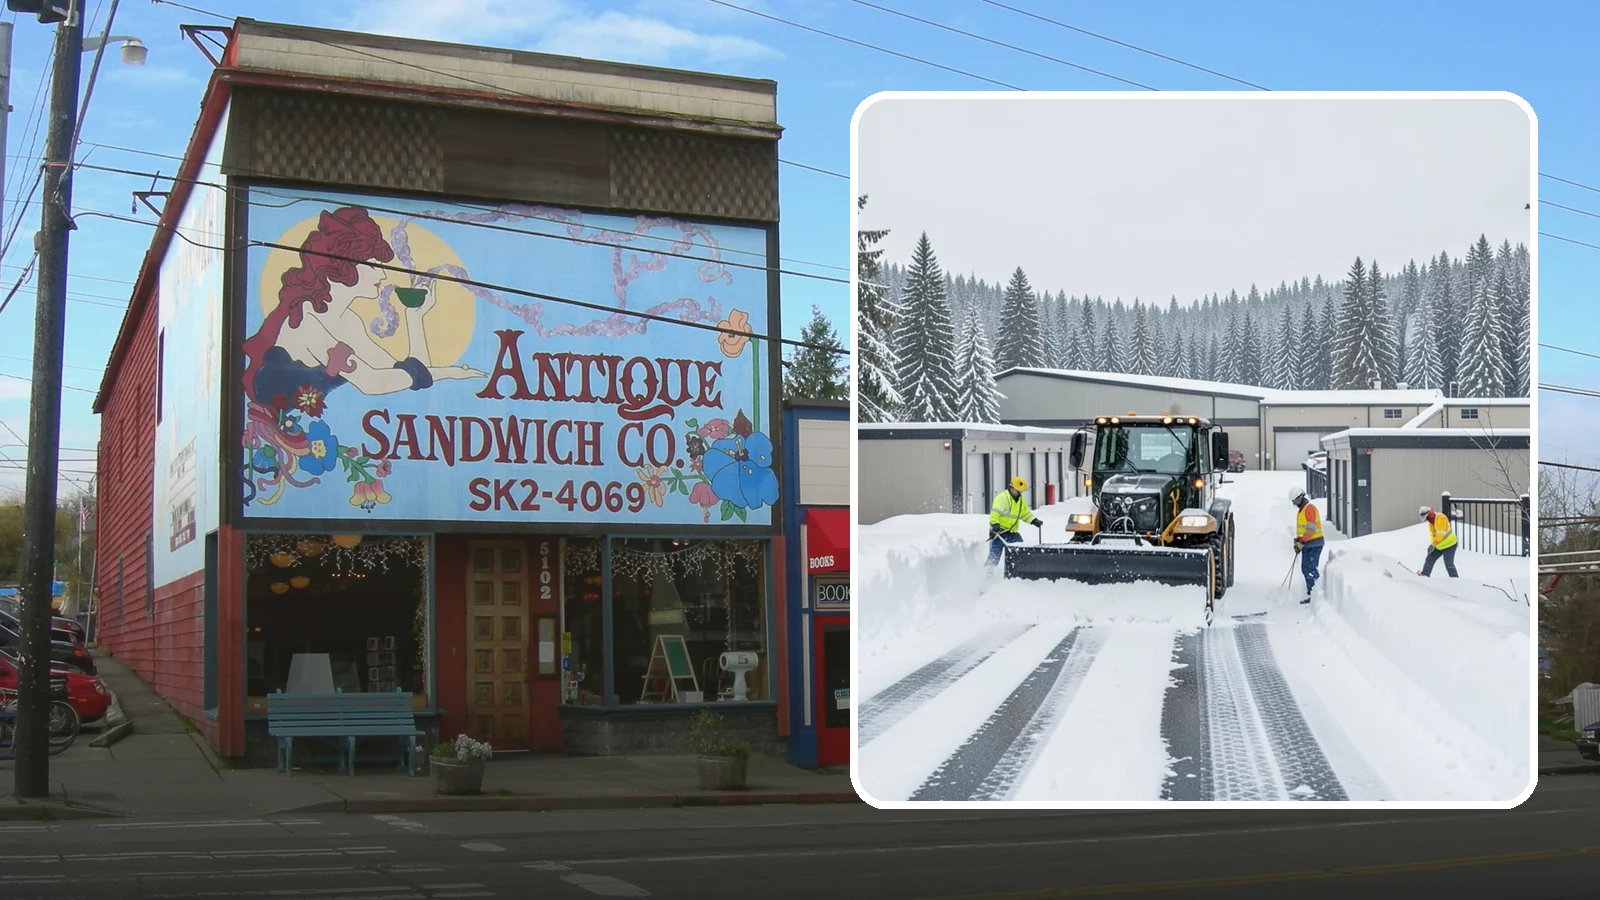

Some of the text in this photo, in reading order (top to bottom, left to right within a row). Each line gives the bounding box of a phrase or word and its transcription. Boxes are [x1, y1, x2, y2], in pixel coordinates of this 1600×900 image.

[476, 329, 723, 421] ANTIQUE
[361, 408, 685, 468] SANDWICH CO.
[468, 477, 646, 513] SK2-4069
[540, 542, 552, 599] 5102
[809, 555, 835, 569] BOOKS
